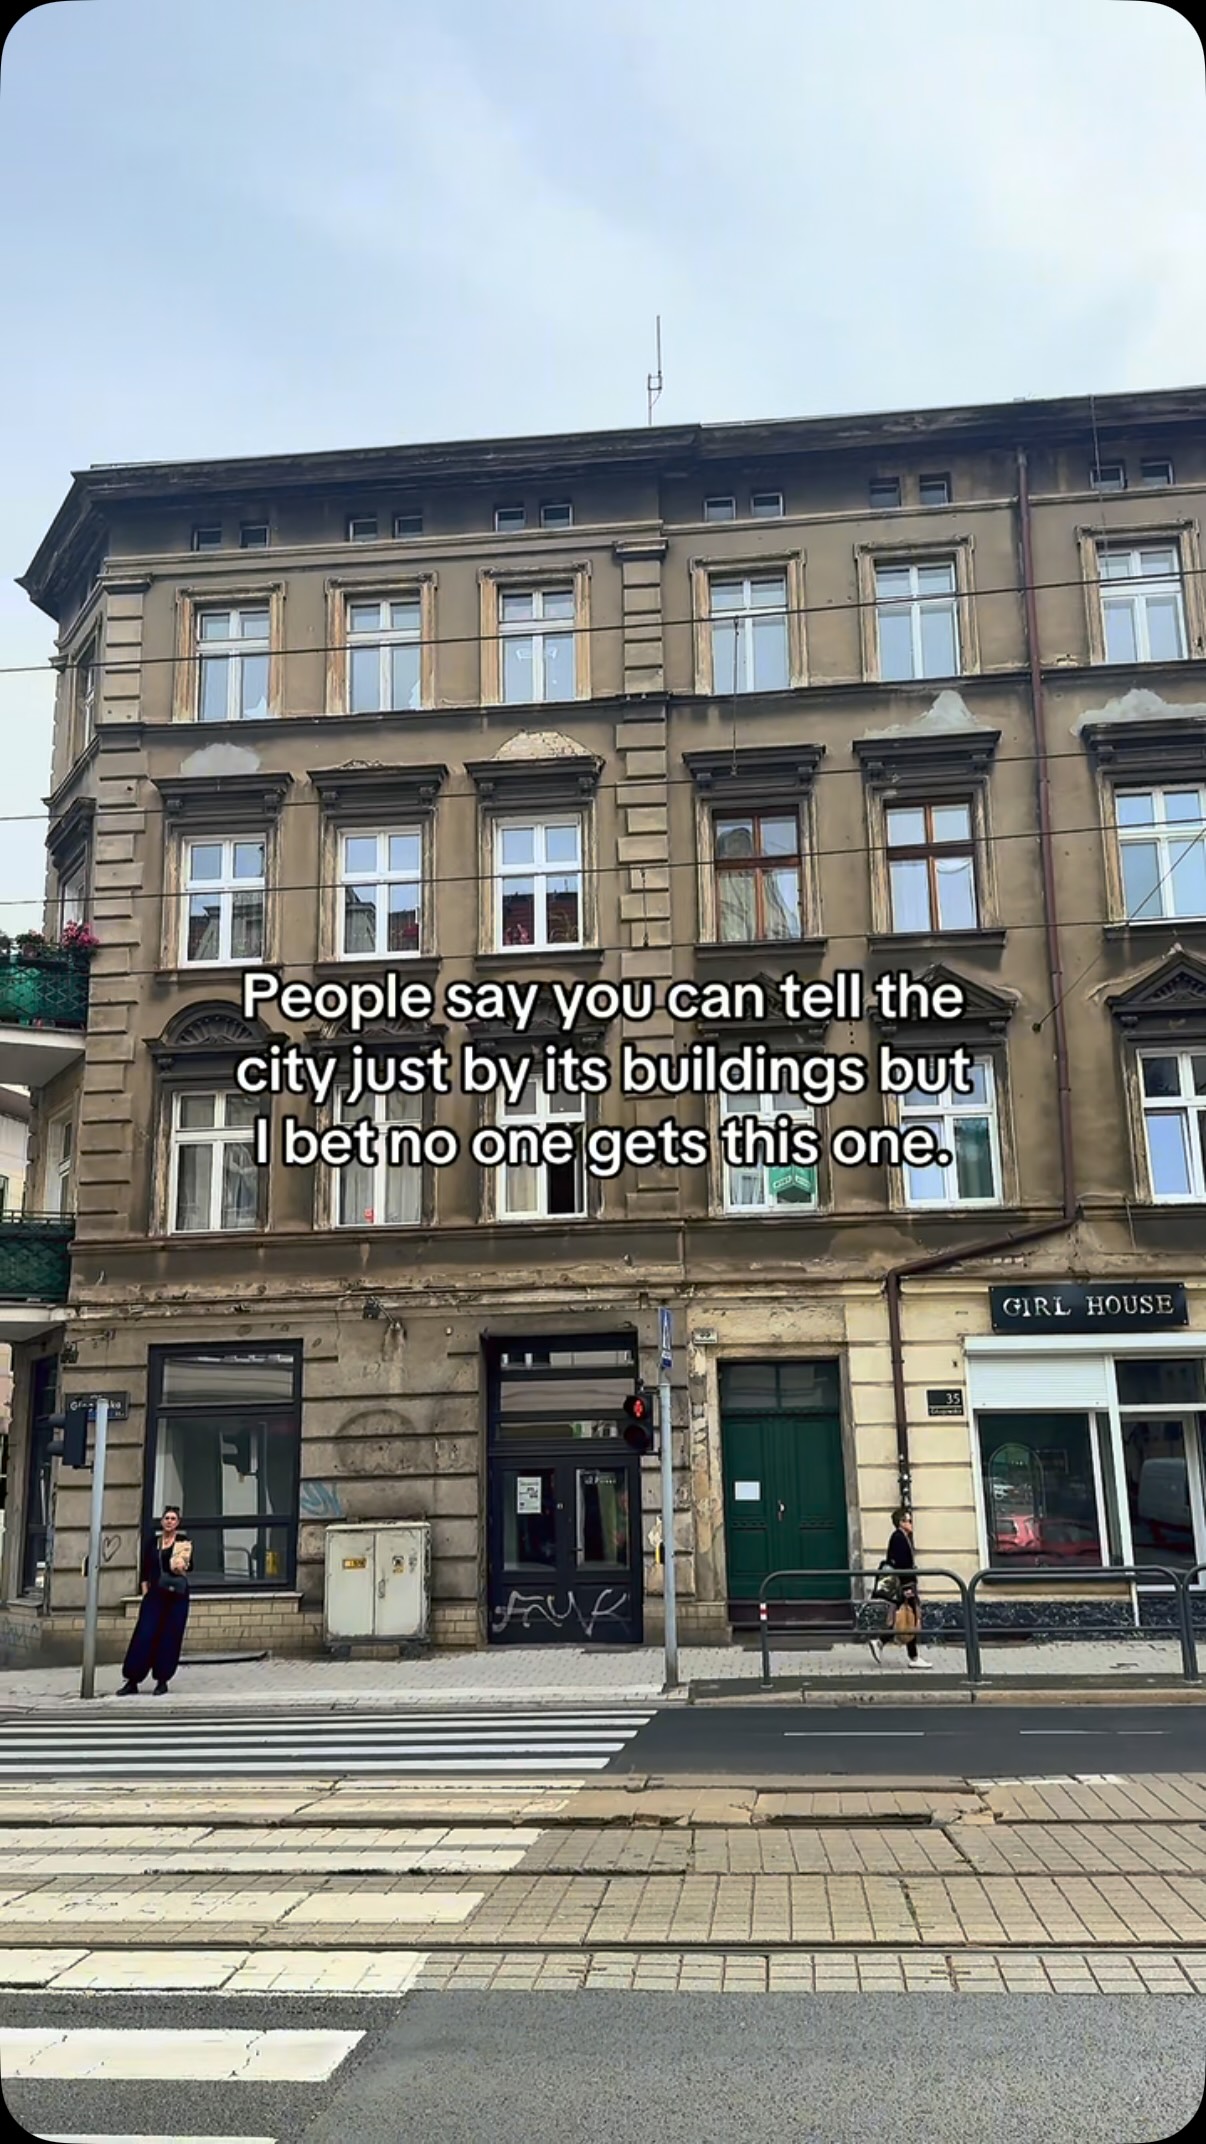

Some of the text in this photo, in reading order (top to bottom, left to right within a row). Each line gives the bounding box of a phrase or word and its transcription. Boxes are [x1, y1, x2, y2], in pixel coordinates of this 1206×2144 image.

[1002, 1294, 1175, 1318] GIRL HOUSE
[945, 1393, 961, 1405] 35
